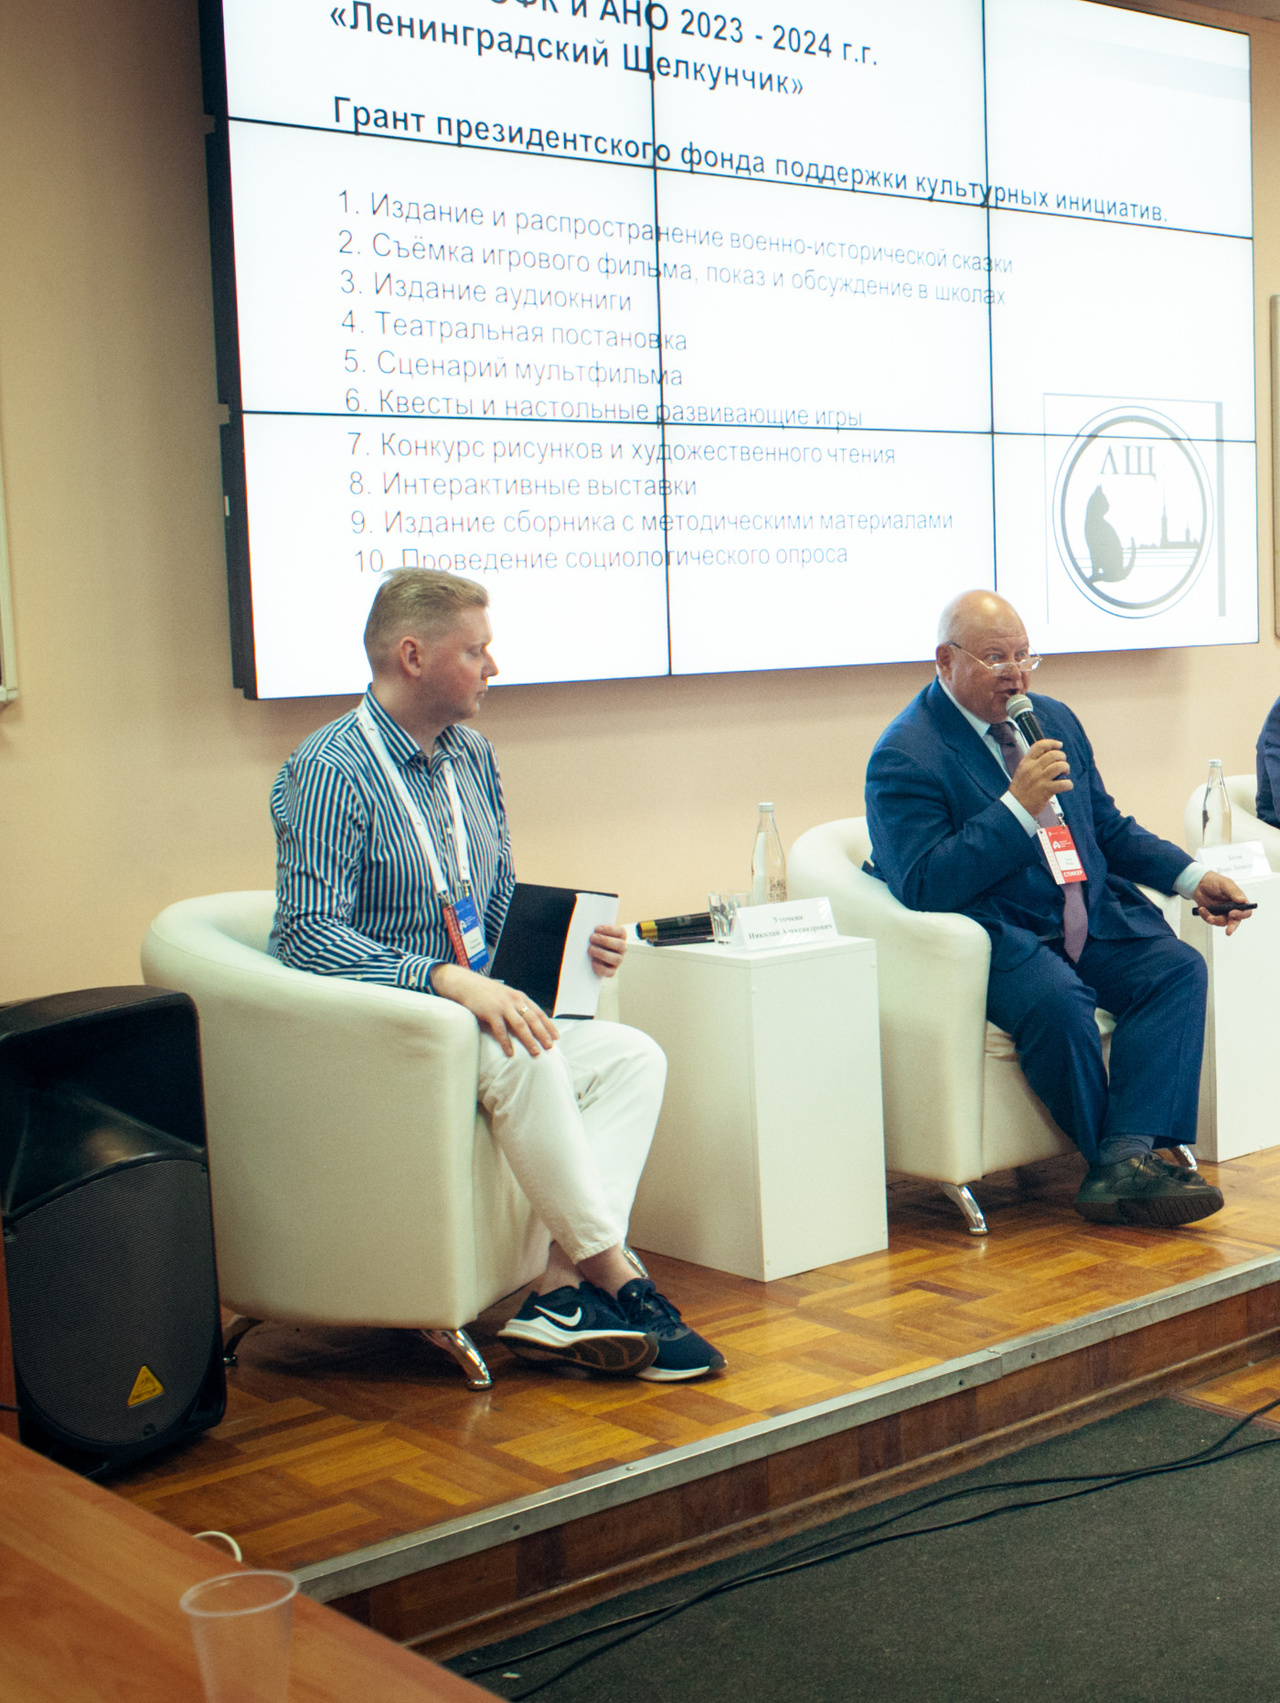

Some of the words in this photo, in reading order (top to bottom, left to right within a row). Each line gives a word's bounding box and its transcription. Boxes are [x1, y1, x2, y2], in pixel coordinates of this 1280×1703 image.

[330, 1, 610, 68] «Ленинградский
[623, 43, 804, 97] Щелкунчик»
[599, 0, 669, 31] АНО
[681, 8, 744, 44] 2023
[772, 24, 832, 60] 2024
[842, 41, 878, 66] г.г.
[334, 96, 425, 136] Грант
[437, 116, 671, 162] президентского
[681, 141, 764, 175] фонда
[775, 157, 907, 192] поддержки
[916, 175, 1049, 210] культурных
[1056, 191, 1168, 223] инициатив.
[339, 190, 359, 215] 1.
[371, 192, 484, 227] Издание
[493, 211, 506, 228] и
[515, 212, 724, 249] распространение
[730, 229, 947, 270] военно-исторической
[952, 252, 1012, 274] сказки
[339, 230, 361, 256] 2.
[373, 233, 474, 265] Съёмка
[482, 247, 590, 278] игрового
[598, 250, 699, 285] фильма,
[707, 263, 765, 287] показ
[774, 269, 784, 288] и
[791, 266, 912, 300] обсуждение
[918, 280, 929, 299] в
[935, 280, 1006, 306] школах
[341, 269, 363, 295] 3.
[374, 271, 487, 305] Издание
[496, 284, 632, 313] аудиокниги
[341, 309, 364, 334] 4.
[375, 311, 544, 343] Театральная
[552, 327, 687, 351] постановка
[344, 348, 366, 373] 5.
[377, 350, 507, 383] Сценарий
[515, 361, 683, 387] мультфильма
[345, 388, 368, 413] 6.
[379, 389, 474, 416] Квесты
[482, 399, 496, 416] и
[505, 397, 649, 421] настольные
[656, 403, 809, 430] развивающие
[816, 408, 863, 434] игры
[348, 432, 369, 456] 7.
[381, 432, 485, 463] Конкурс
[493, 440, 603, 464] рисунков
[610, 444, 623, 460] и
[631, 442, 822, 466] художественного
[827, 446, 896, 464] чтения
[349, 471, 371, 495] 8.
[383, 471, 580, 500] Интерактивные
[588, 479, 697, 497] выставки
[351, 510, 373, 534] 9.
[385, 510, 496, 537] Издание
[503, 509, 615, 537] сборника
[623, 516, 634, 533] с
[642, 512, 813, 534] методическими
[820, 511, 953, 534] материалами
[402, 549, 558, 573] Проведение
[566, 547, 771, 573] социологического
[776, 545, 848, 569] опроса
